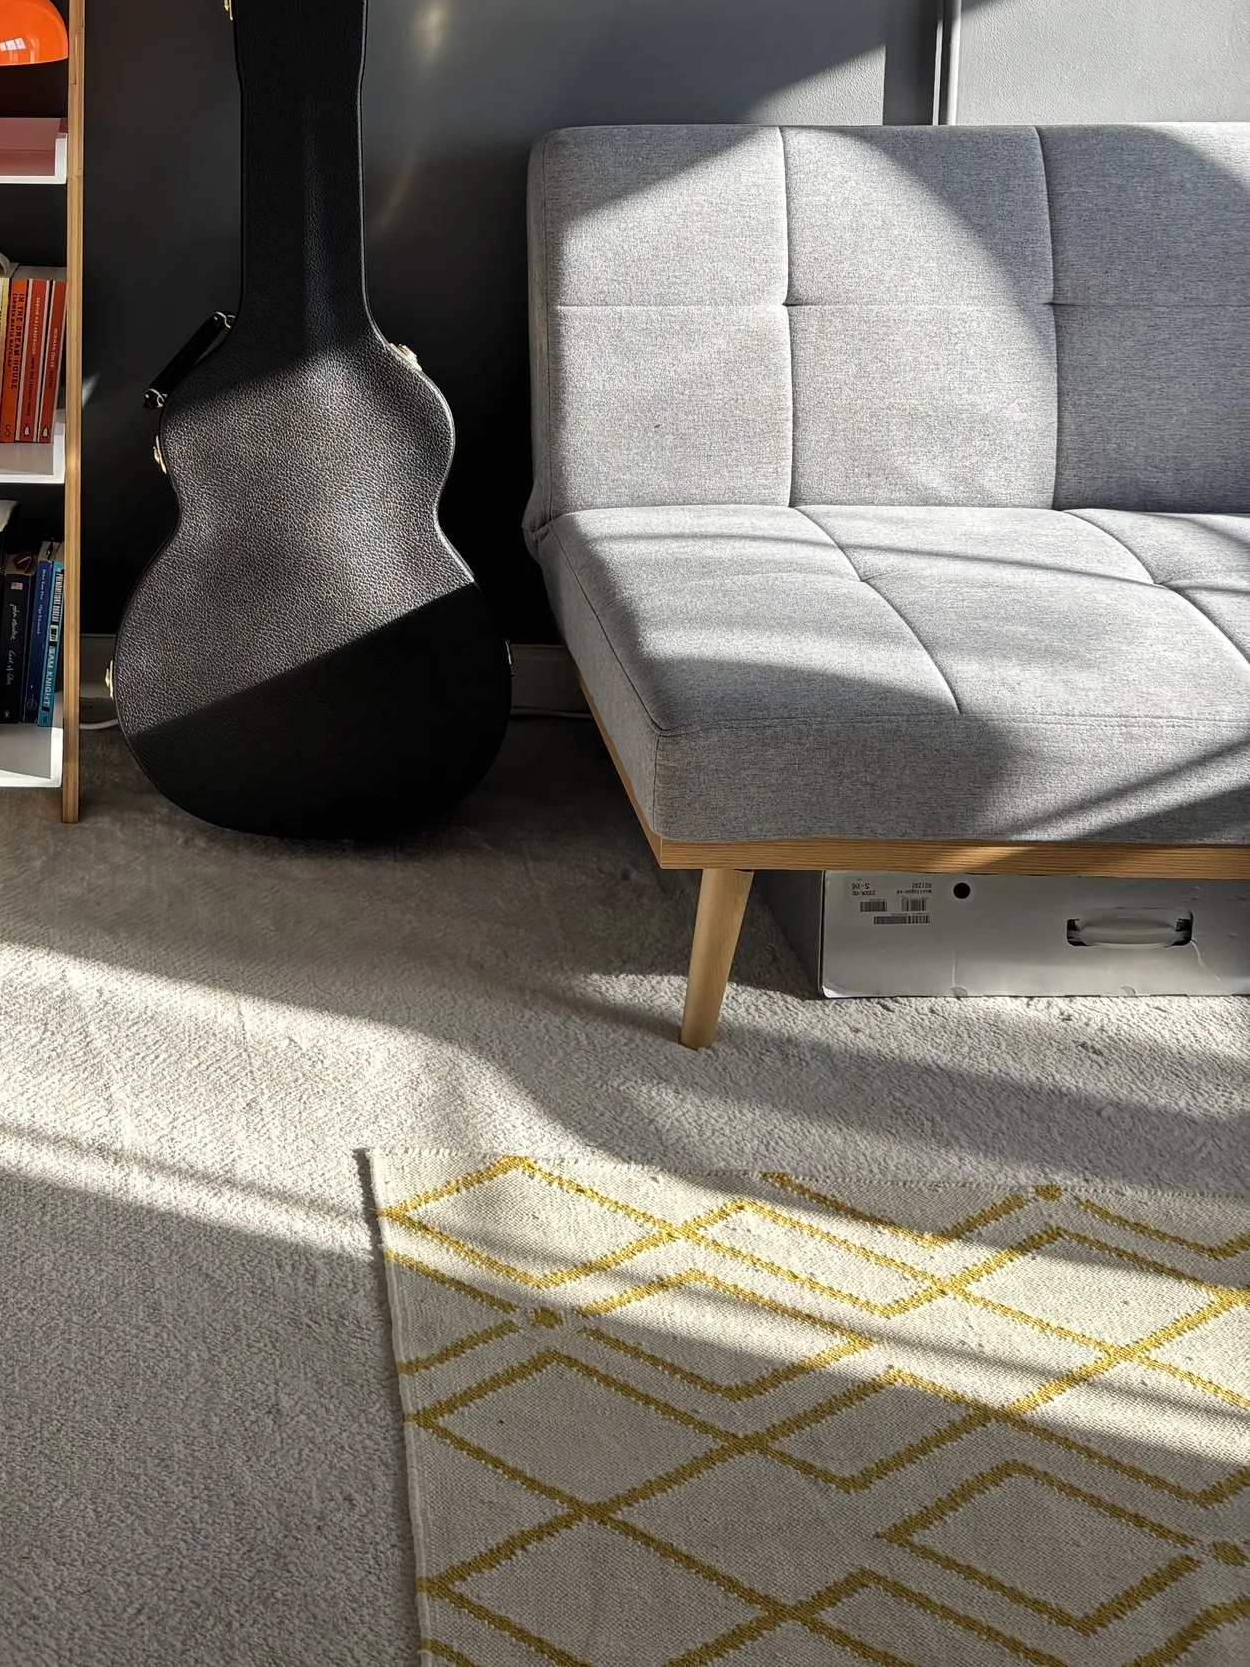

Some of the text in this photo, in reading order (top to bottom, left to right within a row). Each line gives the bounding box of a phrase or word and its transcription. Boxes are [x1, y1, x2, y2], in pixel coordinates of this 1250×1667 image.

[10, 293, 24, 390] IN THE DREAM HOUSE
[50, 328, 58, 351] NORMAN
[43, 645, 56, 707] SAM KNIGHT
